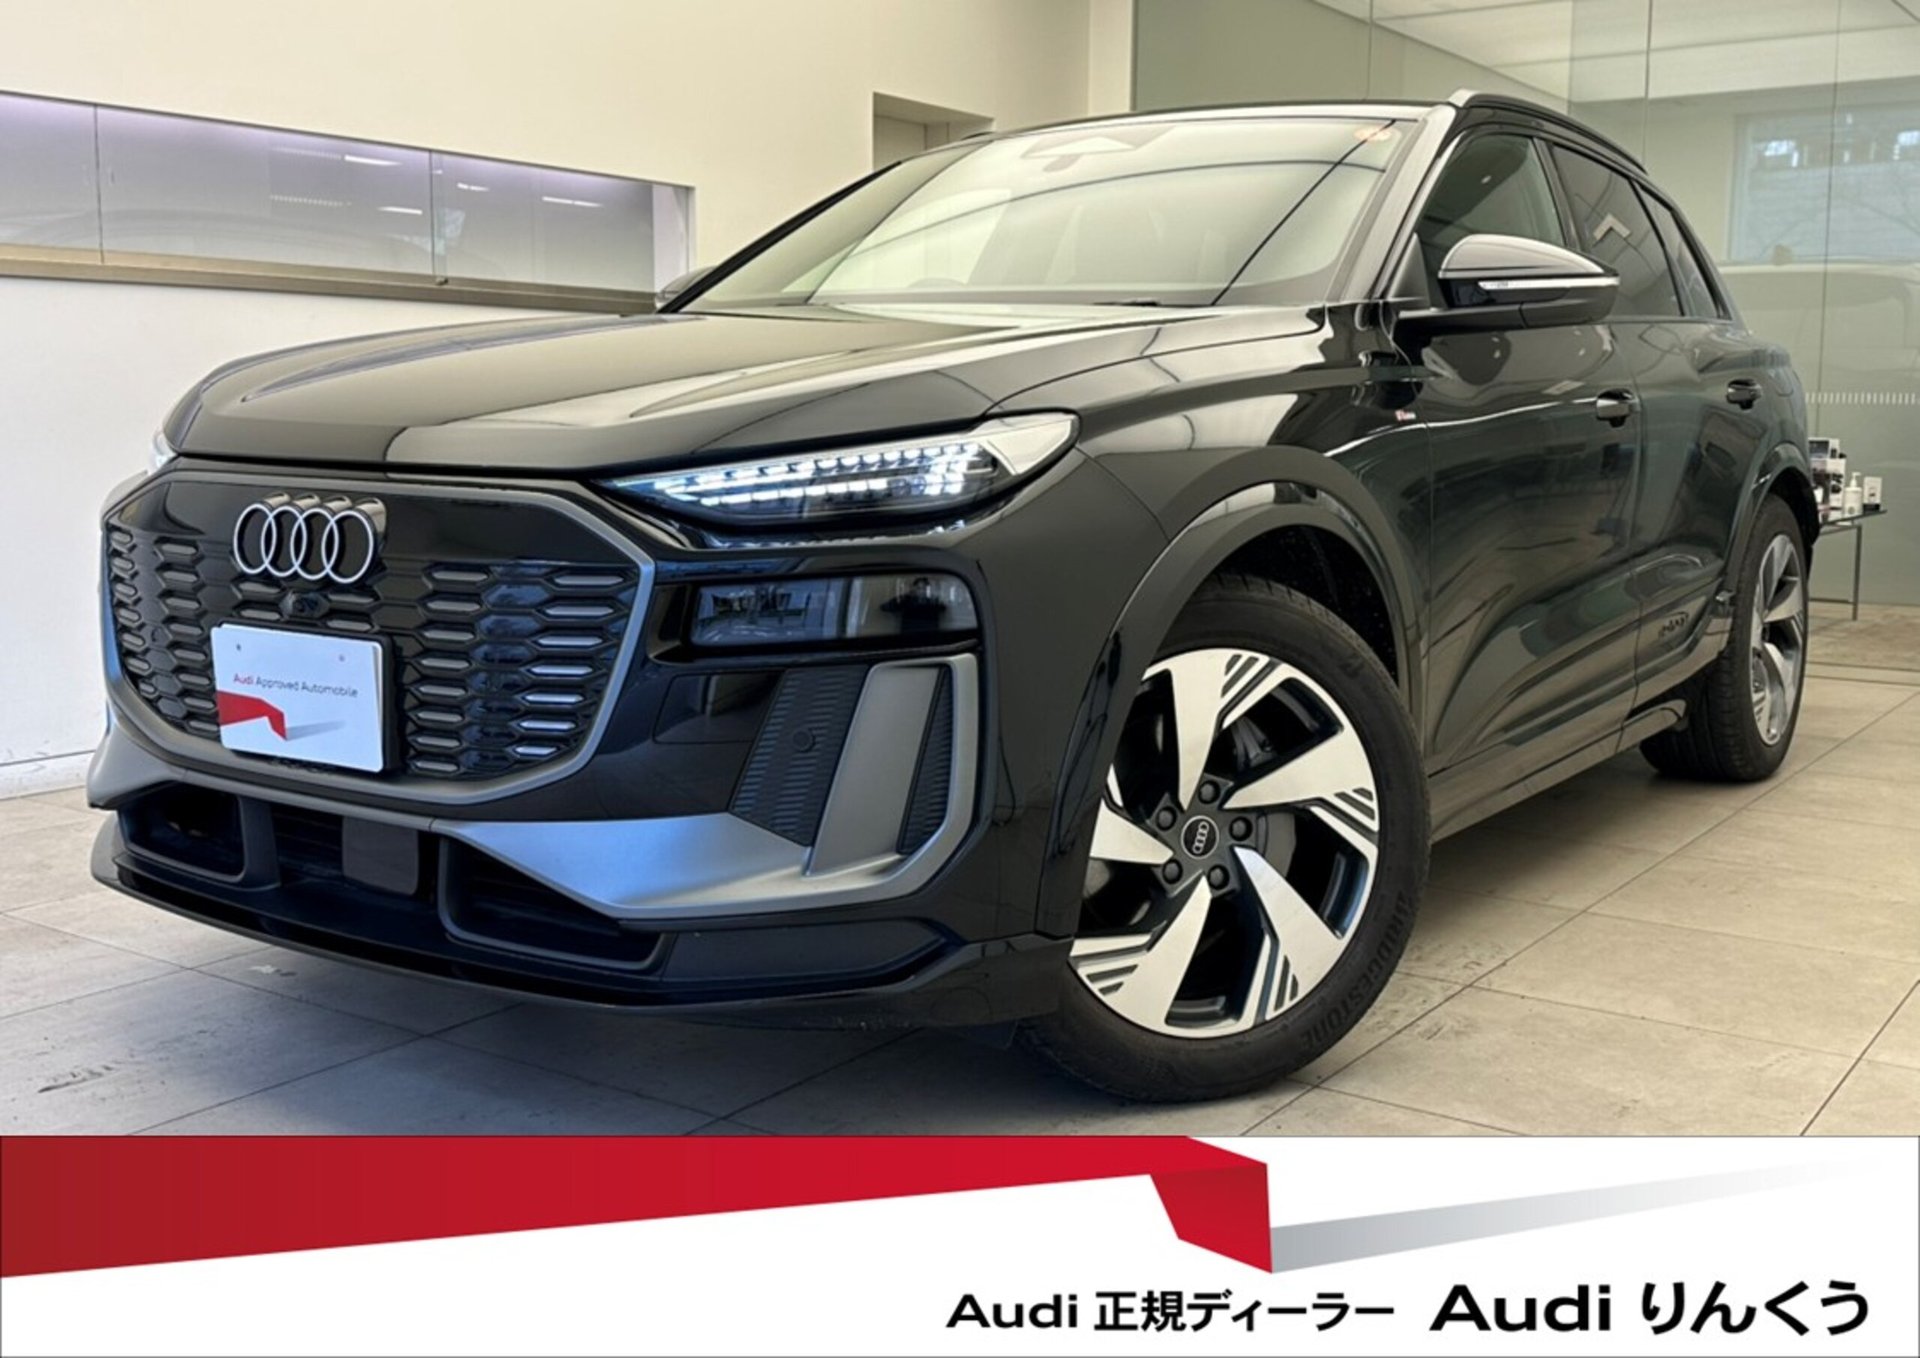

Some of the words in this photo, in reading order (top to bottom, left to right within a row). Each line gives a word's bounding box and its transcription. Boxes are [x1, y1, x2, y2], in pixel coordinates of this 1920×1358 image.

[233, 673, 254, 686] Audi
[256, 676, 299, 691] Approved
[301, 681, 358, 697] Automobile
[1301, 890, 1415, 1050] BRIDGESTONE
